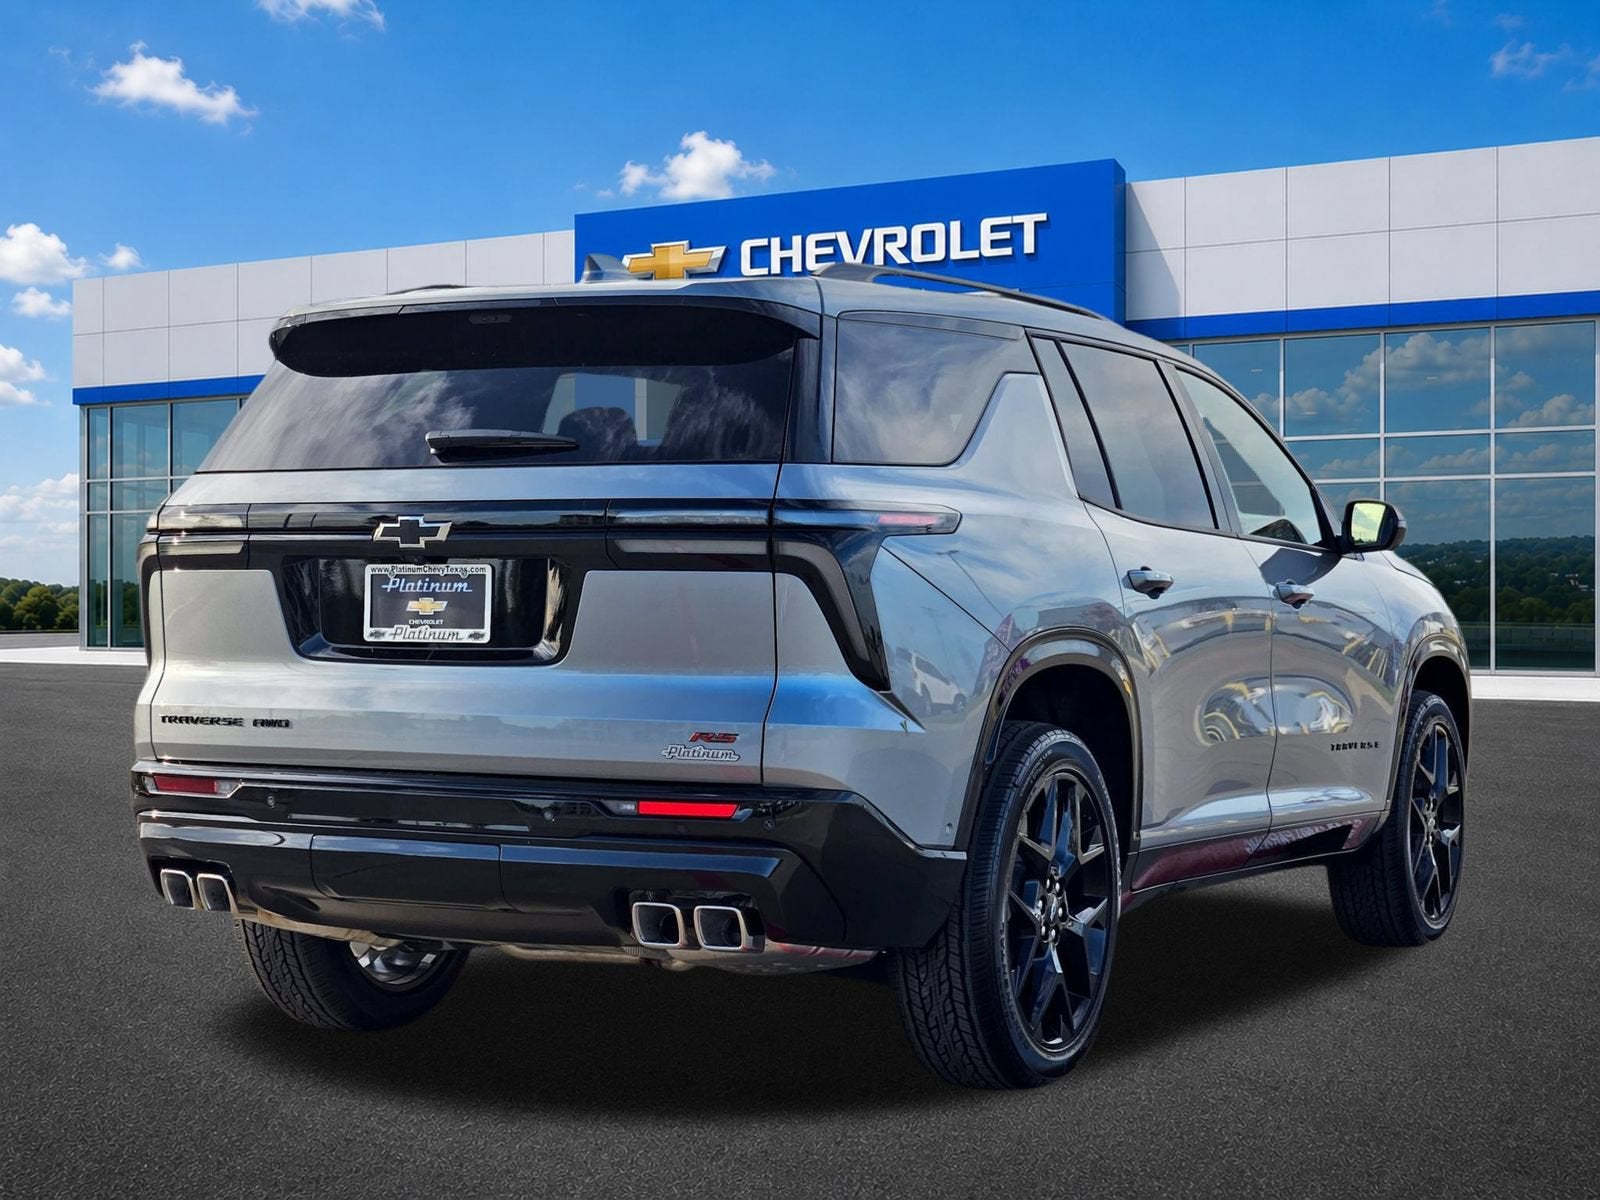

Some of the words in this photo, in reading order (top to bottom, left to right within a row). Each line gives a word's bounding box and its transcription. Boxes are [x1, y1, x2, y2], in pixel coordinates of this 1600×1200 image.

[740, 212, 1048, 277] CHEVROLET
[381, 577, 473, 593] Platinum
[390, 626, 464, 641] Platinum
[160, 714, 245, 727] TRAVERSE
[252, 718, 292, 729] AWD
[688, 731, 740, 744] RS
[662, 744, 740, 761] Platinum
[1330, 741, 1381, 752] TRAVERSE
